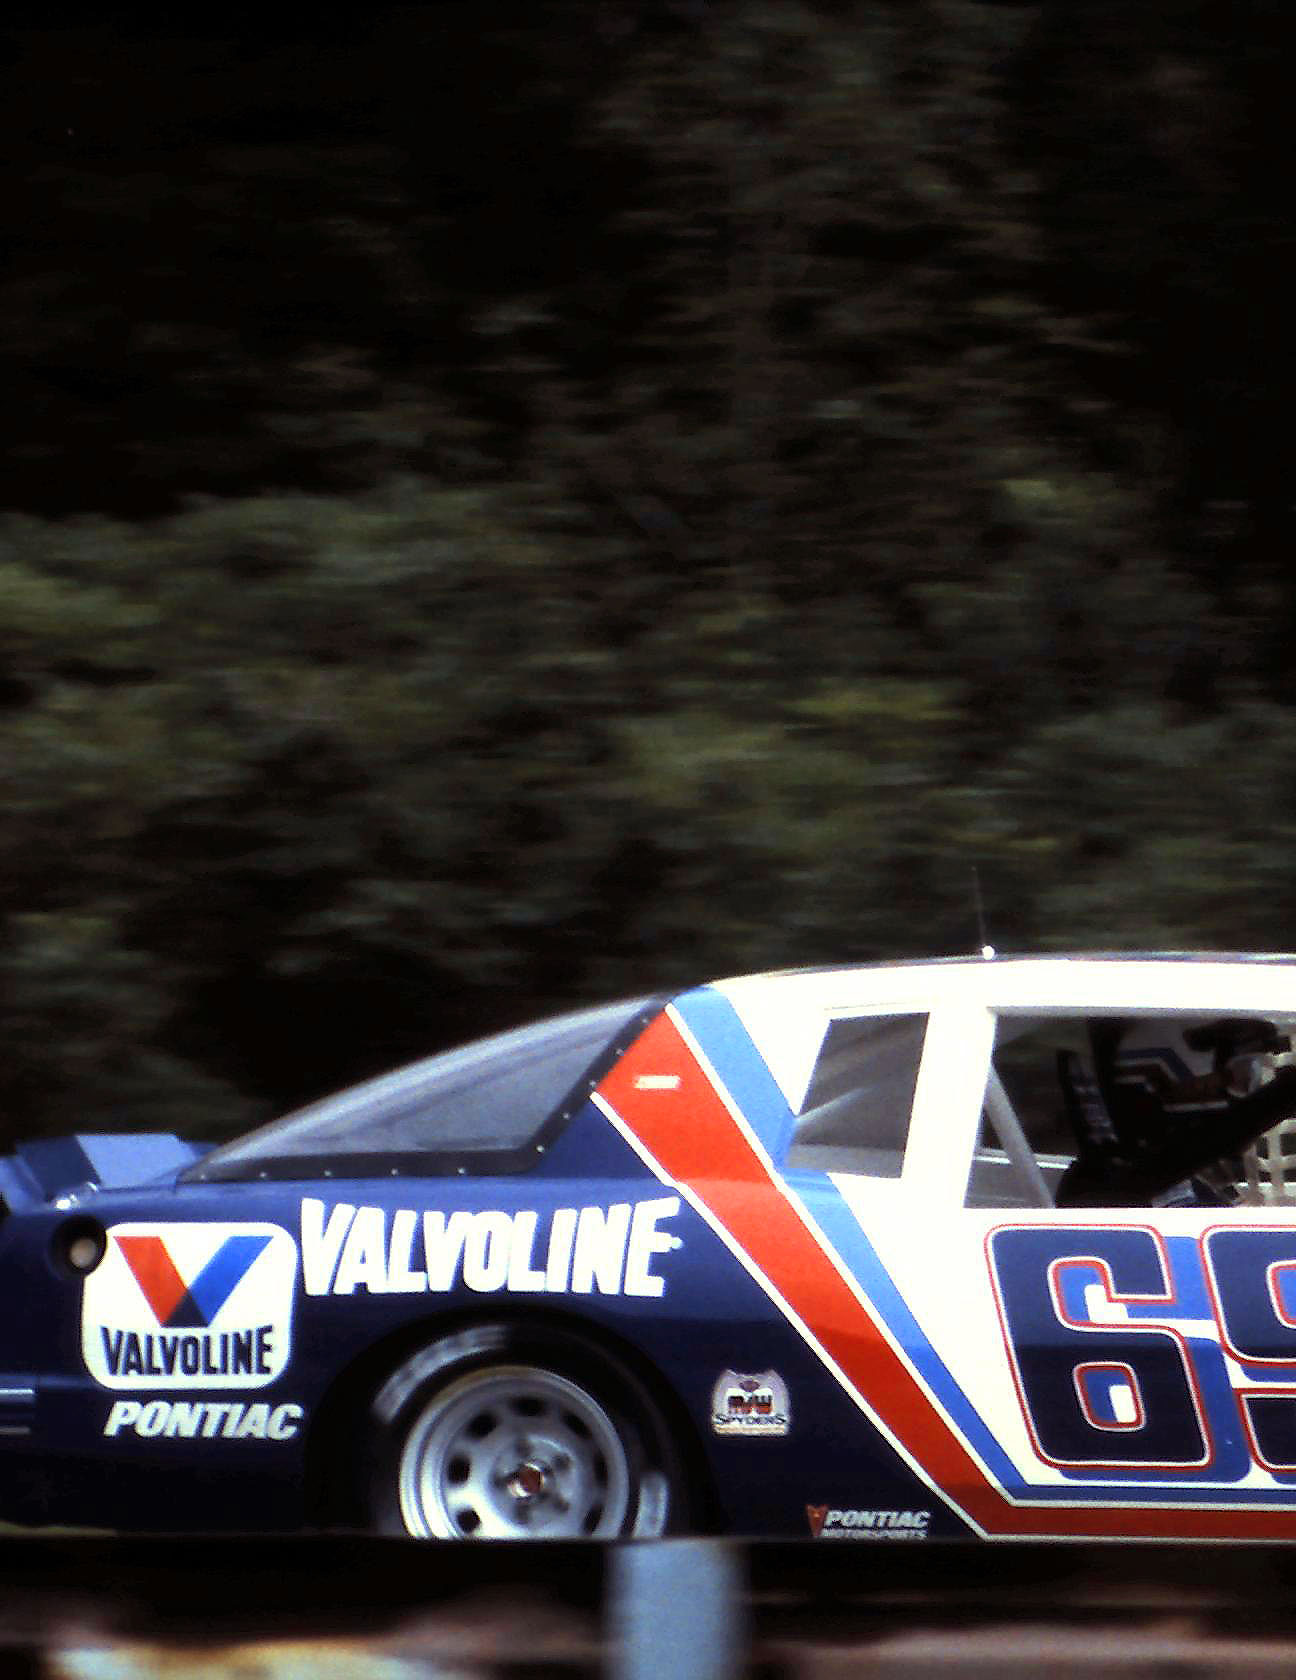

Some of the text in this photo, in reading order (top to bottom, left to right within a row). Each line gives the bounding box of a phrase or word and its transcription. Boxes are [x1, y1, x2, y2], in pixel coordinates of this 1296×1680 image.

[302, 1197, 681, 1297] VALVOLINE
[101, 1326, 273, 1376] VALVOLINE
[104, 1402, 303, 1440] PONTIAC
[824, 1509, 931, 1528] PONTIAC
